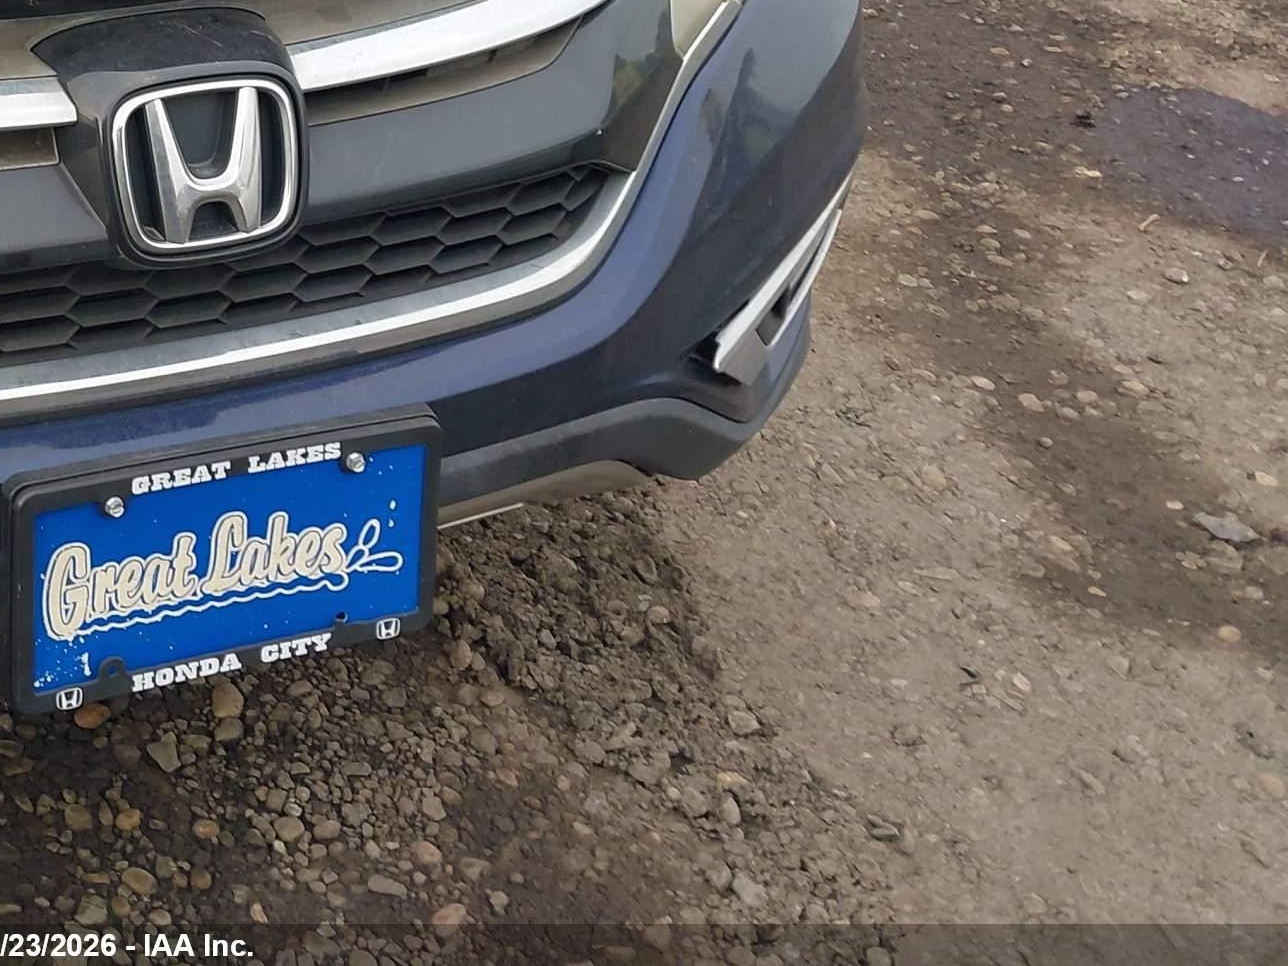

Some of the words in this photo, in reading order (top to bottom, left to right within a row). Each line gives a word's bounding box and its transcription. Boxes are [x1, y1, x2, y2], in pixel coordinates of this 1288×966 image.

[131, 460, 231, 496] GREAT
[248, 442, 342, 475] LAKES
[43, 531, 200, 642] Great
[200, 510, 348, 596] Lakes
[131, 653, 242, 693] HONDA
[260, 633, 332, 664] CITY
